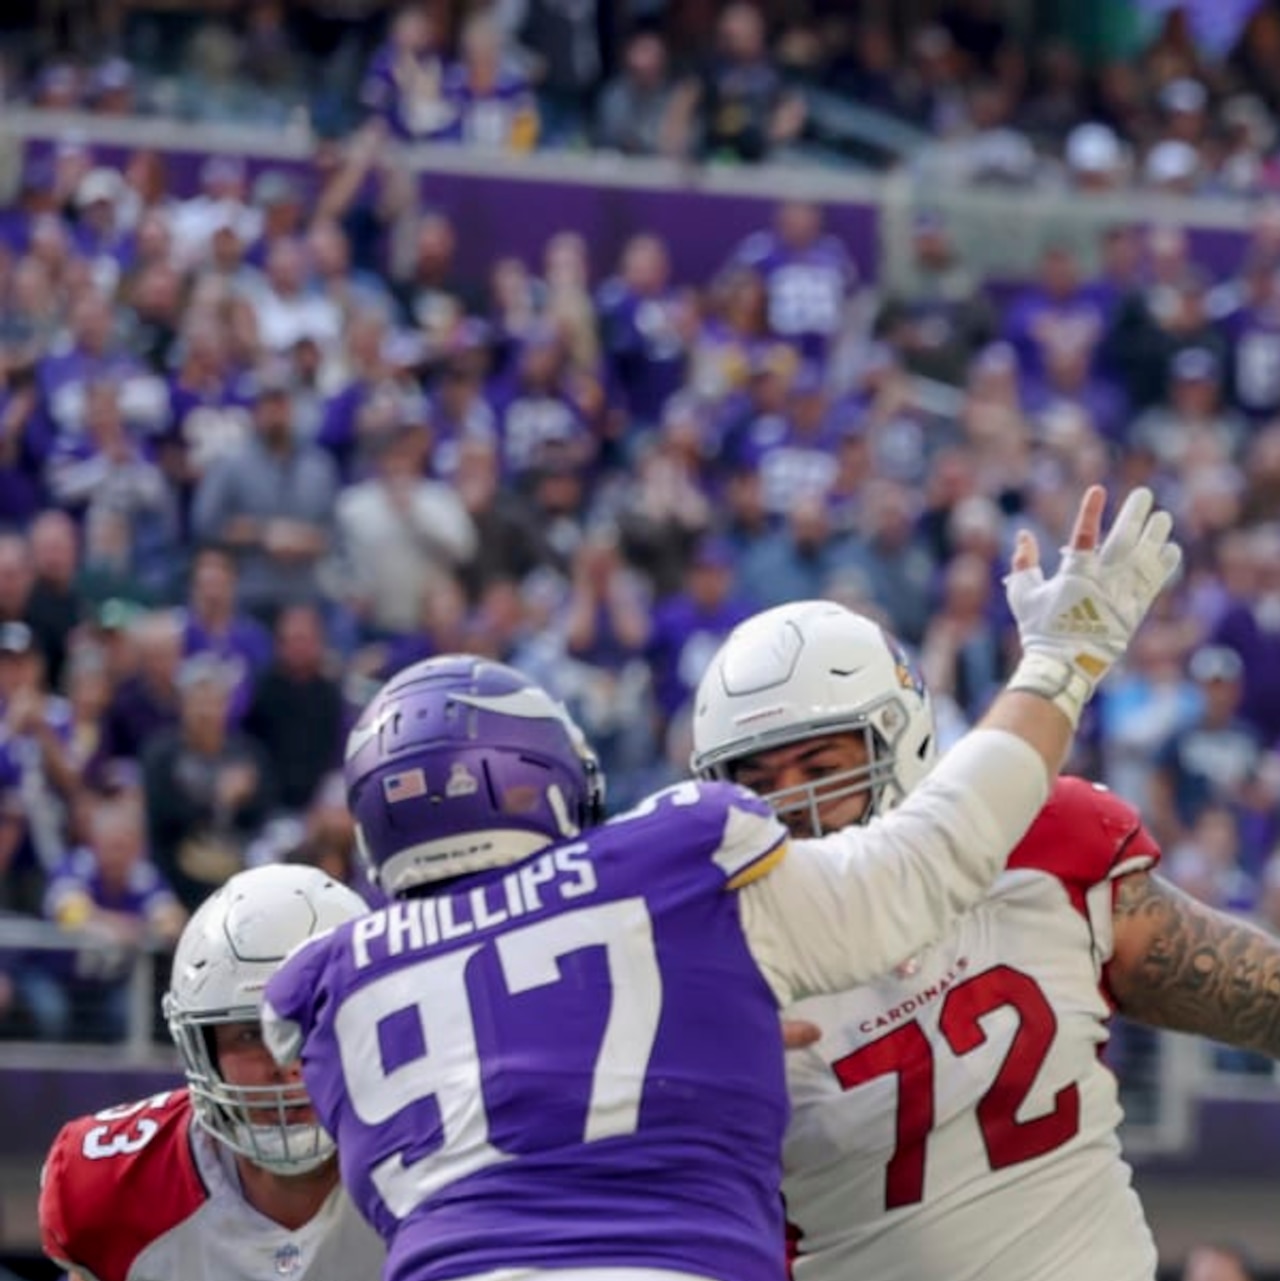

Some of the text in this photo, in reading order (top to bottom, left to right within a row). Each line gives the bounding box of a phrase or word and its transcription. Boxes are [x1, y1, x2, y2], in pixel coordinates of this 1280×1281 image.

[354, 843, 597, 970] PHILLIPS
[859, 956, 970, 1034] CARDINALS
[334, 896, 663, 1219] 97
[832, 963, 1080, 1213] 72
